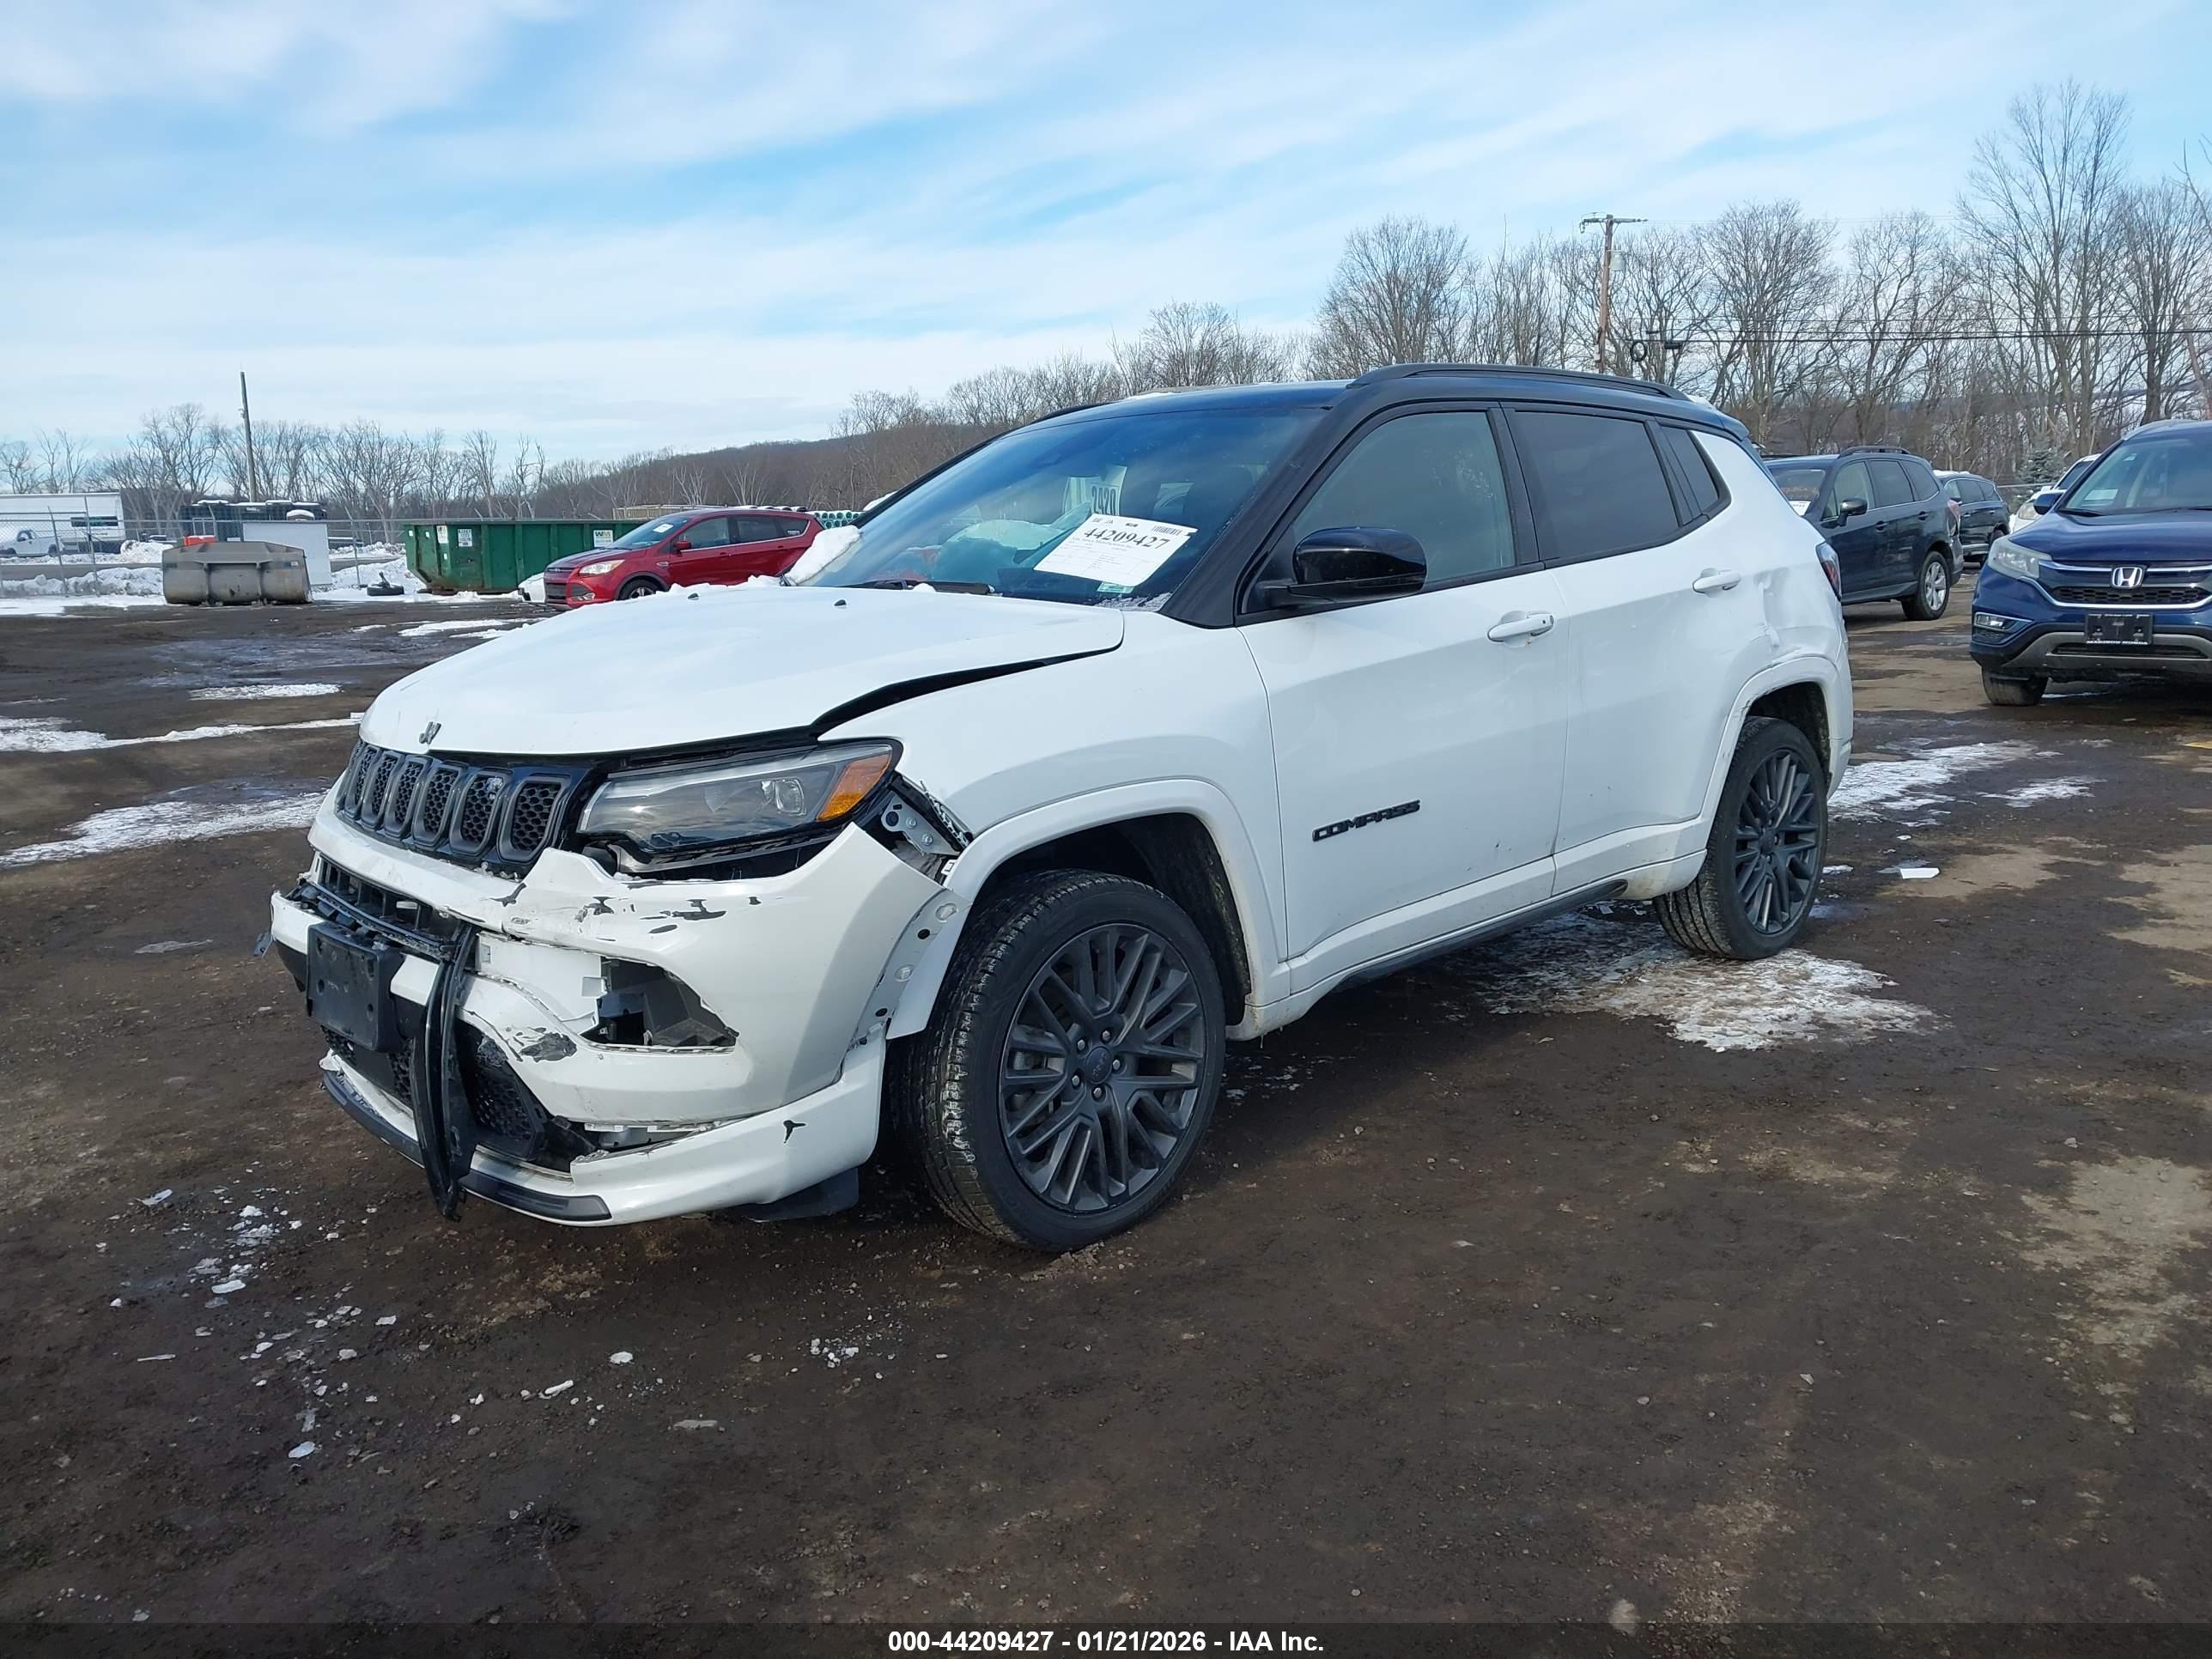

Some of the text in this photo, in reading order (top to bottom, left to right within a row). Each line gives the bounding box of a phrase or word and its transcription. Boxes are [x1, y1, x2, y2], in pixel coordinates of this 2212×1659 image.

[1091, 486, 1116, 515] 2420
[1084, 527, 1171, 550] 44209427
[1312, 799, 1421, 842] COMPASS
